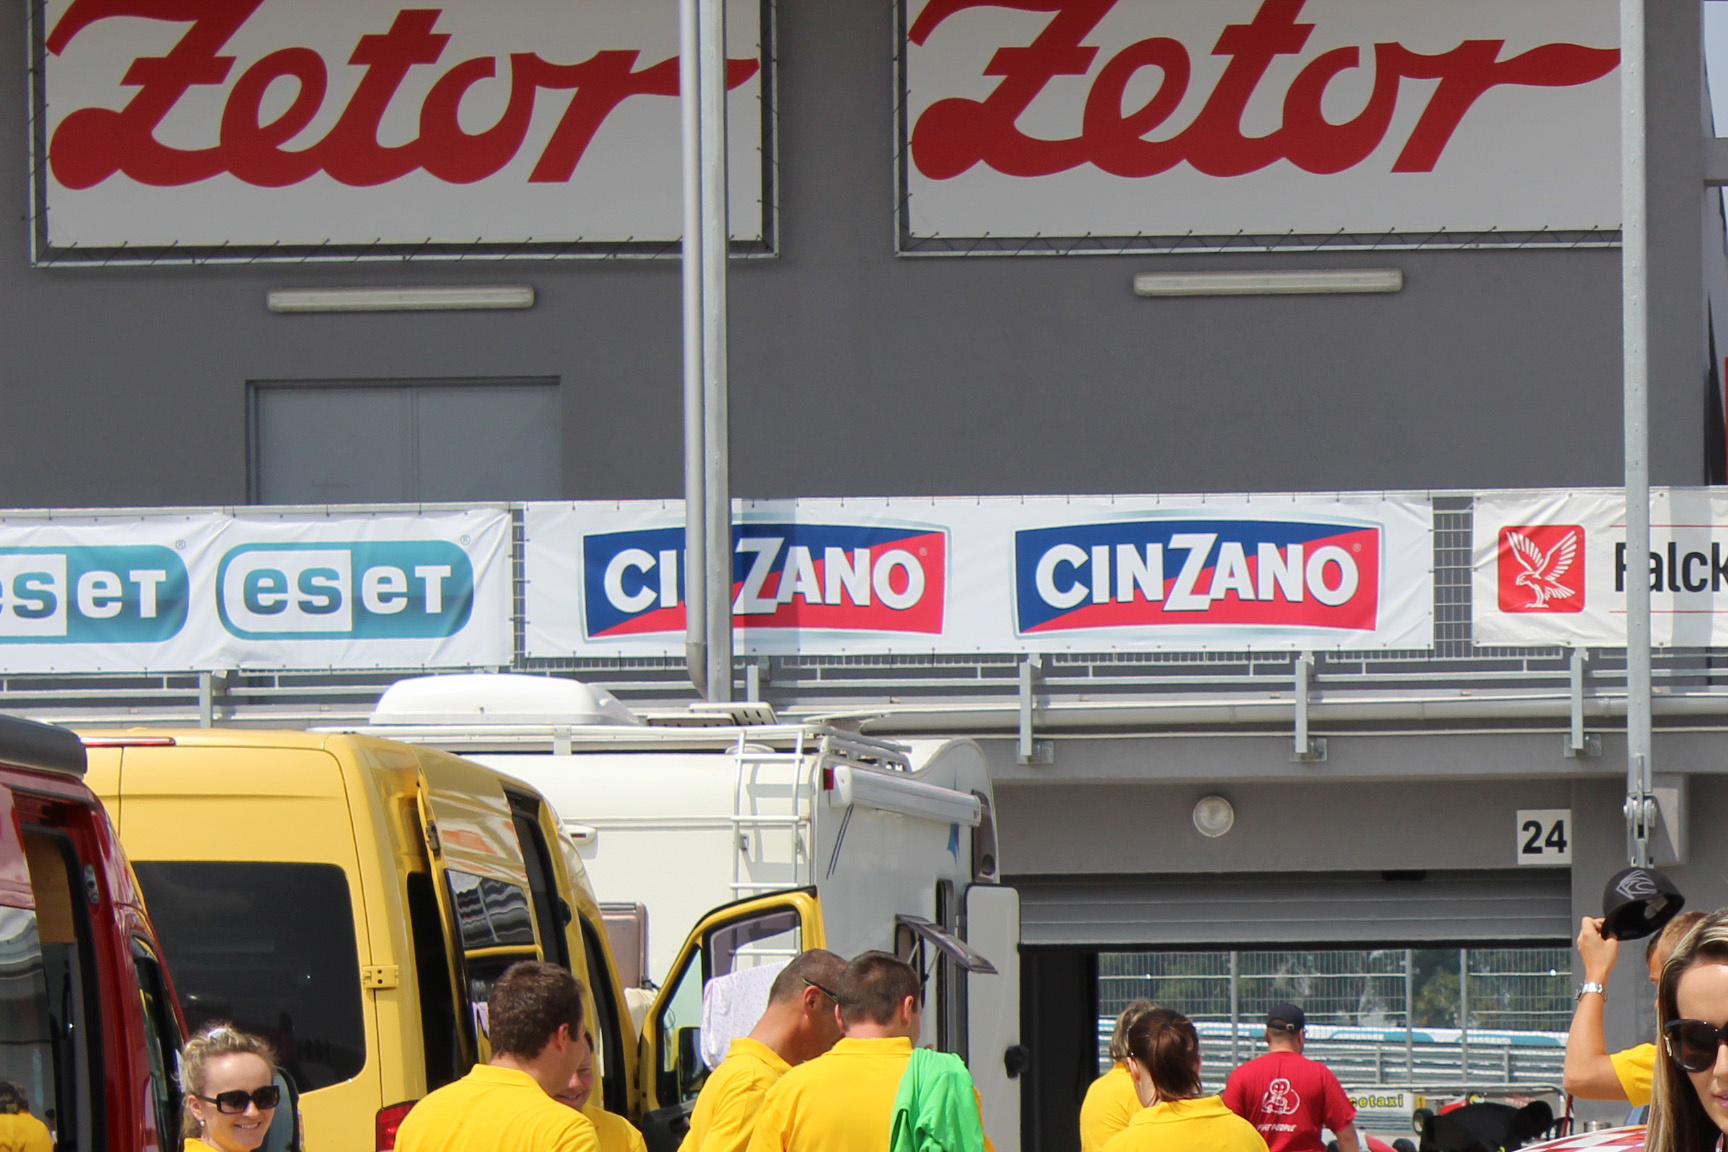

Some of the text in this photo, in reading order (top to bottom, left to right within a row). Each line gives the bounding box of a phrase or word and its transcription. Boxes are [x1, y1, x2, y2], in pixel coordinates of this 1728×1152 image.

[46, 0, 760, 190] Zetor
[907, 0, 1623, 181] Zetor
[604, 537, 926, 615] CIZANO
[1035, 533, 1360, 611] CINZANO
[1521, 819, 1568, 855] 24
